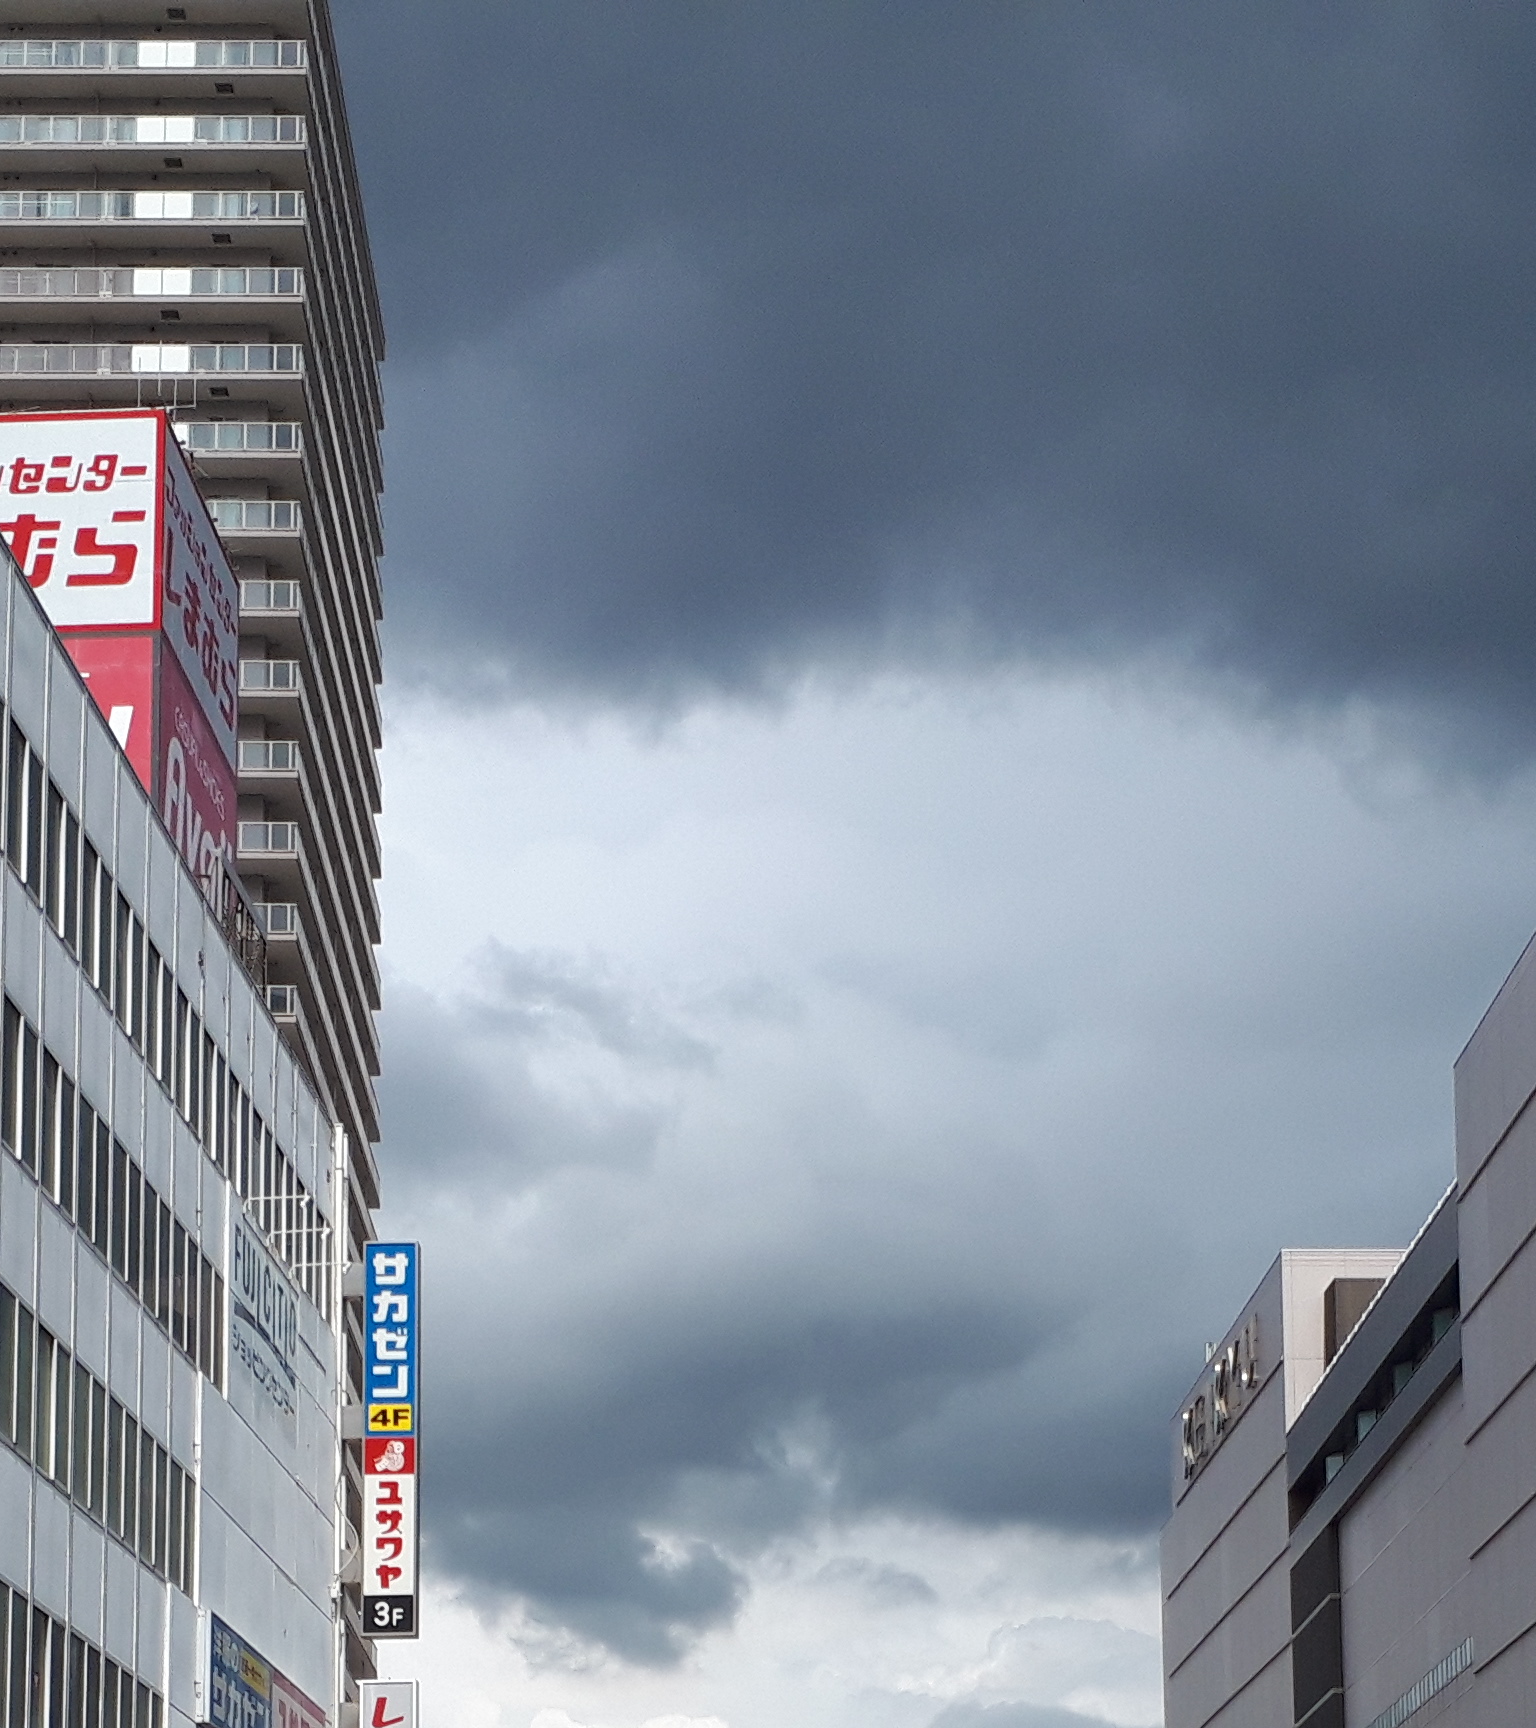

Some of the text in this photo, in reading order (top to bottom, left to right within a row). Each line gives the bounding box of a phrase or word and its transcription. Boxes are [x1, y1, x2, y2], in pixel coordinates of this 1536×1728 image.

[167, 526, 236, 732] しまむら
[372, 1251, 409, 1399] サカゼン
[370, 1408, 411, 1427] 4F
[373, 1602, 404, 1627] 3F
